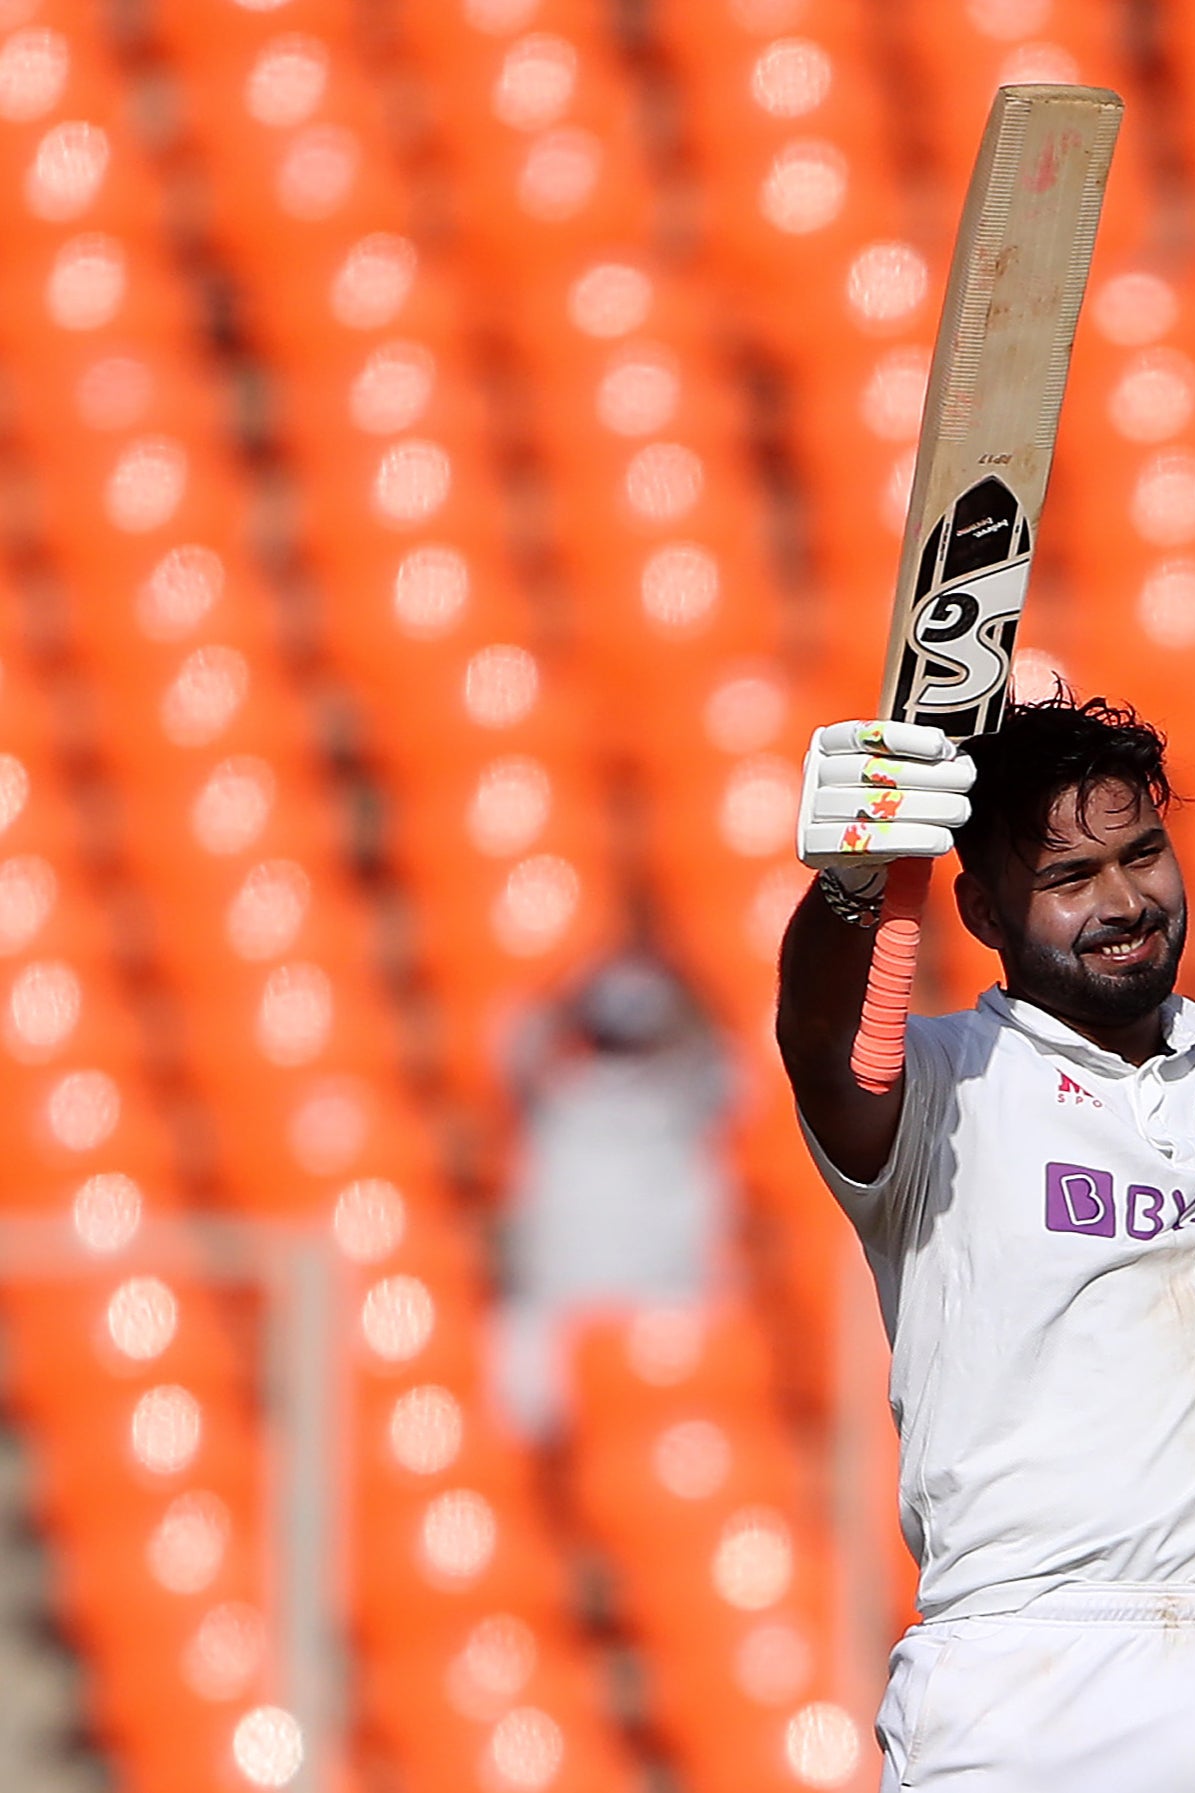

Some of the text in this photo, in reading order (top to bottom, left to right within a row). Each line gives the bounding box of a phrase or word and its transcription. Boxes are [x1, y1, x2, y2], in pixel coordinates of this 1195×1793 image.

[914, 559, 1030, 706] SG
[1057, 1093, 1103, 1108] SPO
[1061, 1173, 1106, 1226] B
